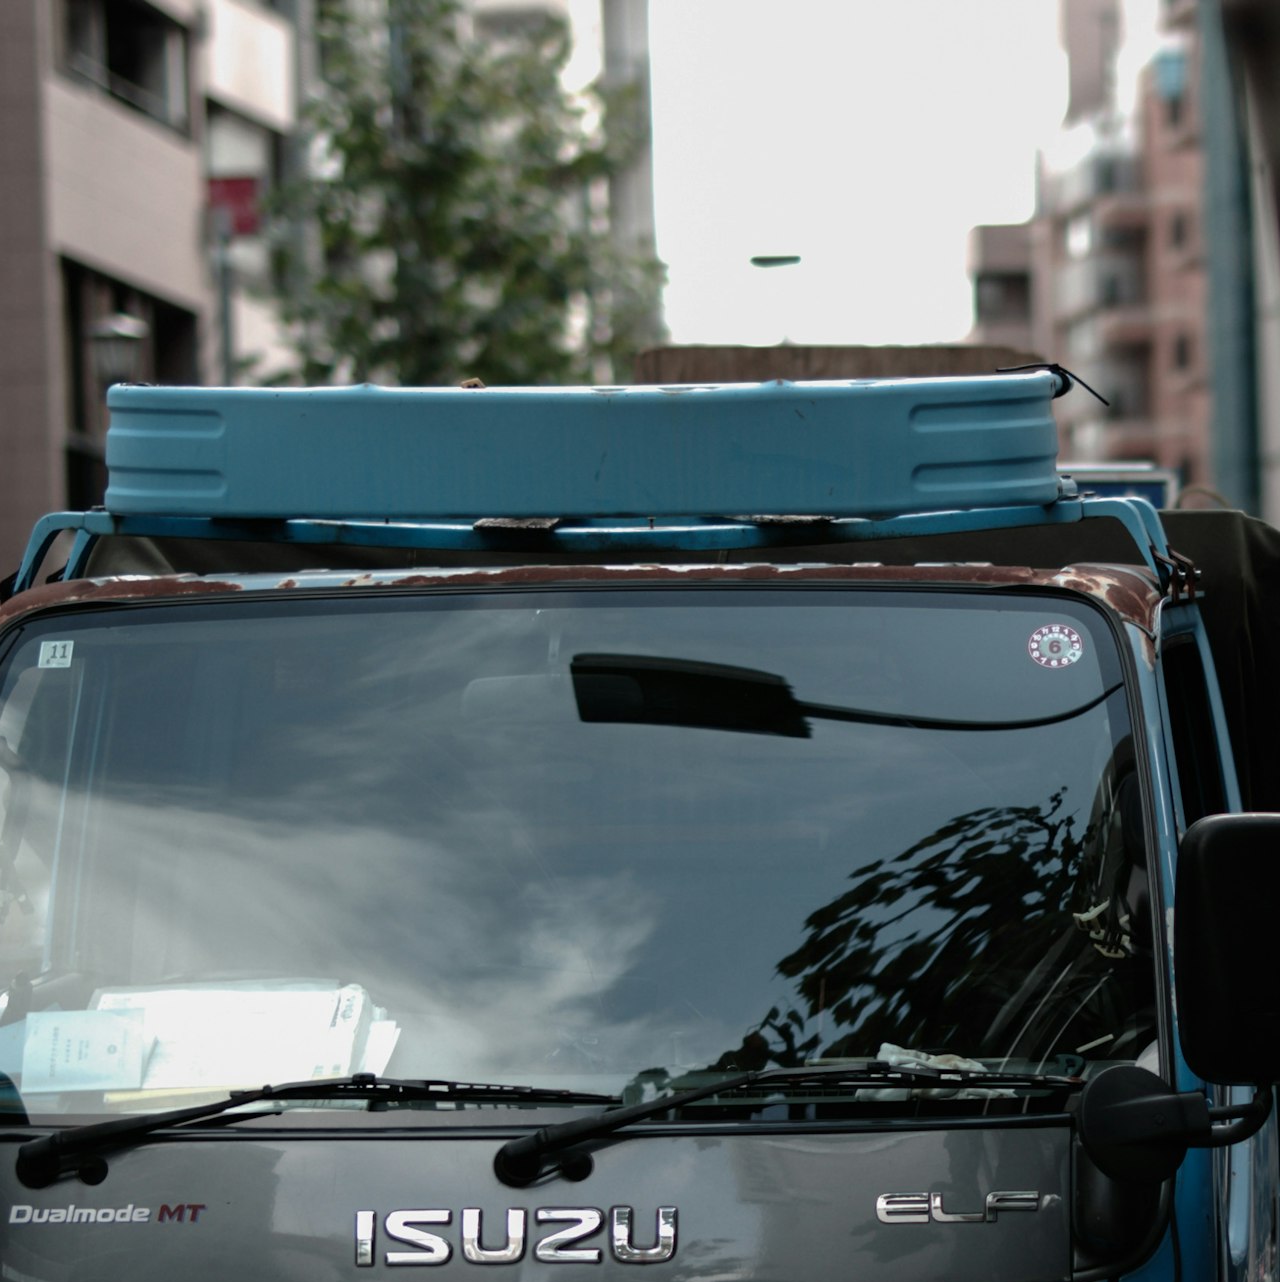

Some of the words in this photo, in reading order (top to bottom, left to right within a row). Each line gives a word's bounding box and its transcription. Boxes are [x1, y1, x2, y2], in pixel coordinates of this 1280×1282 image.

[50, 643, 67, 658] 11
[1048, 640, 1061, 654] 6
[8, 1204, 151, 1224] Dualmode
[157, 1203, 206, 1223] MT
[876, 1190, 1039, 1223] ELF
[354, 1205, 679, 1267] ISUZU
